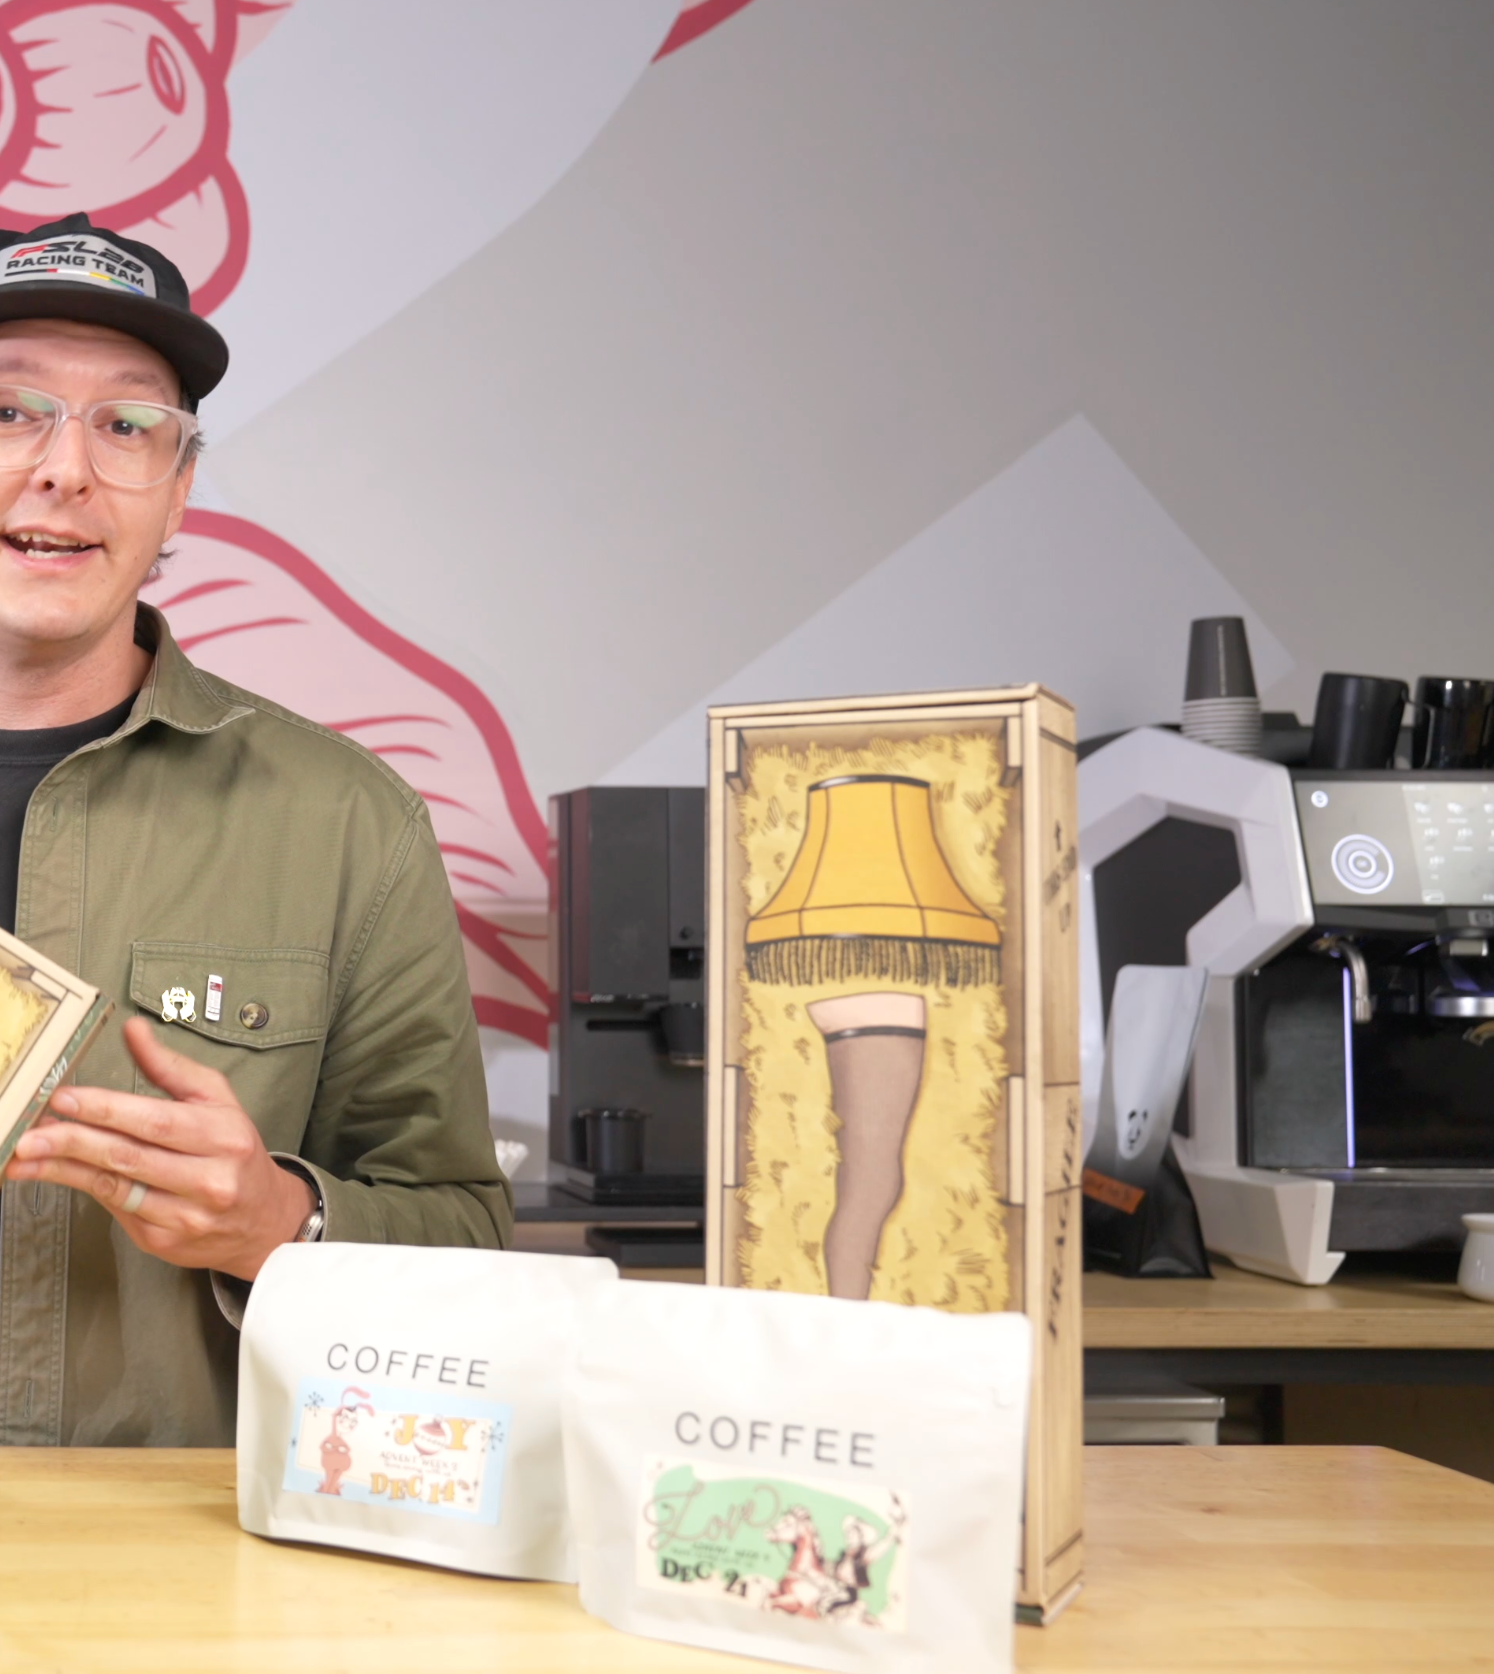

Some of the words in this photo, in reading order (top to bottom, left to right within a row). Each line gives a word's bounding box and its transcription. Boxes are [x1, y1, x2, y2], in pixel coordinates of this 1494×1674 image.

[6, 254, 86, 269] RACING
[92, 259, 145, 288] TEAM
[327, 1343, 489, 1388] COFFEE
[674, 1411, 876, 1468] COFFEE
[370, 1472, 423, 1501] DEC
[643, 1480, 781, 1551] Love
[661, 1557, 712, 1583] DEC
[723, 1569, 748, 1597] 21
